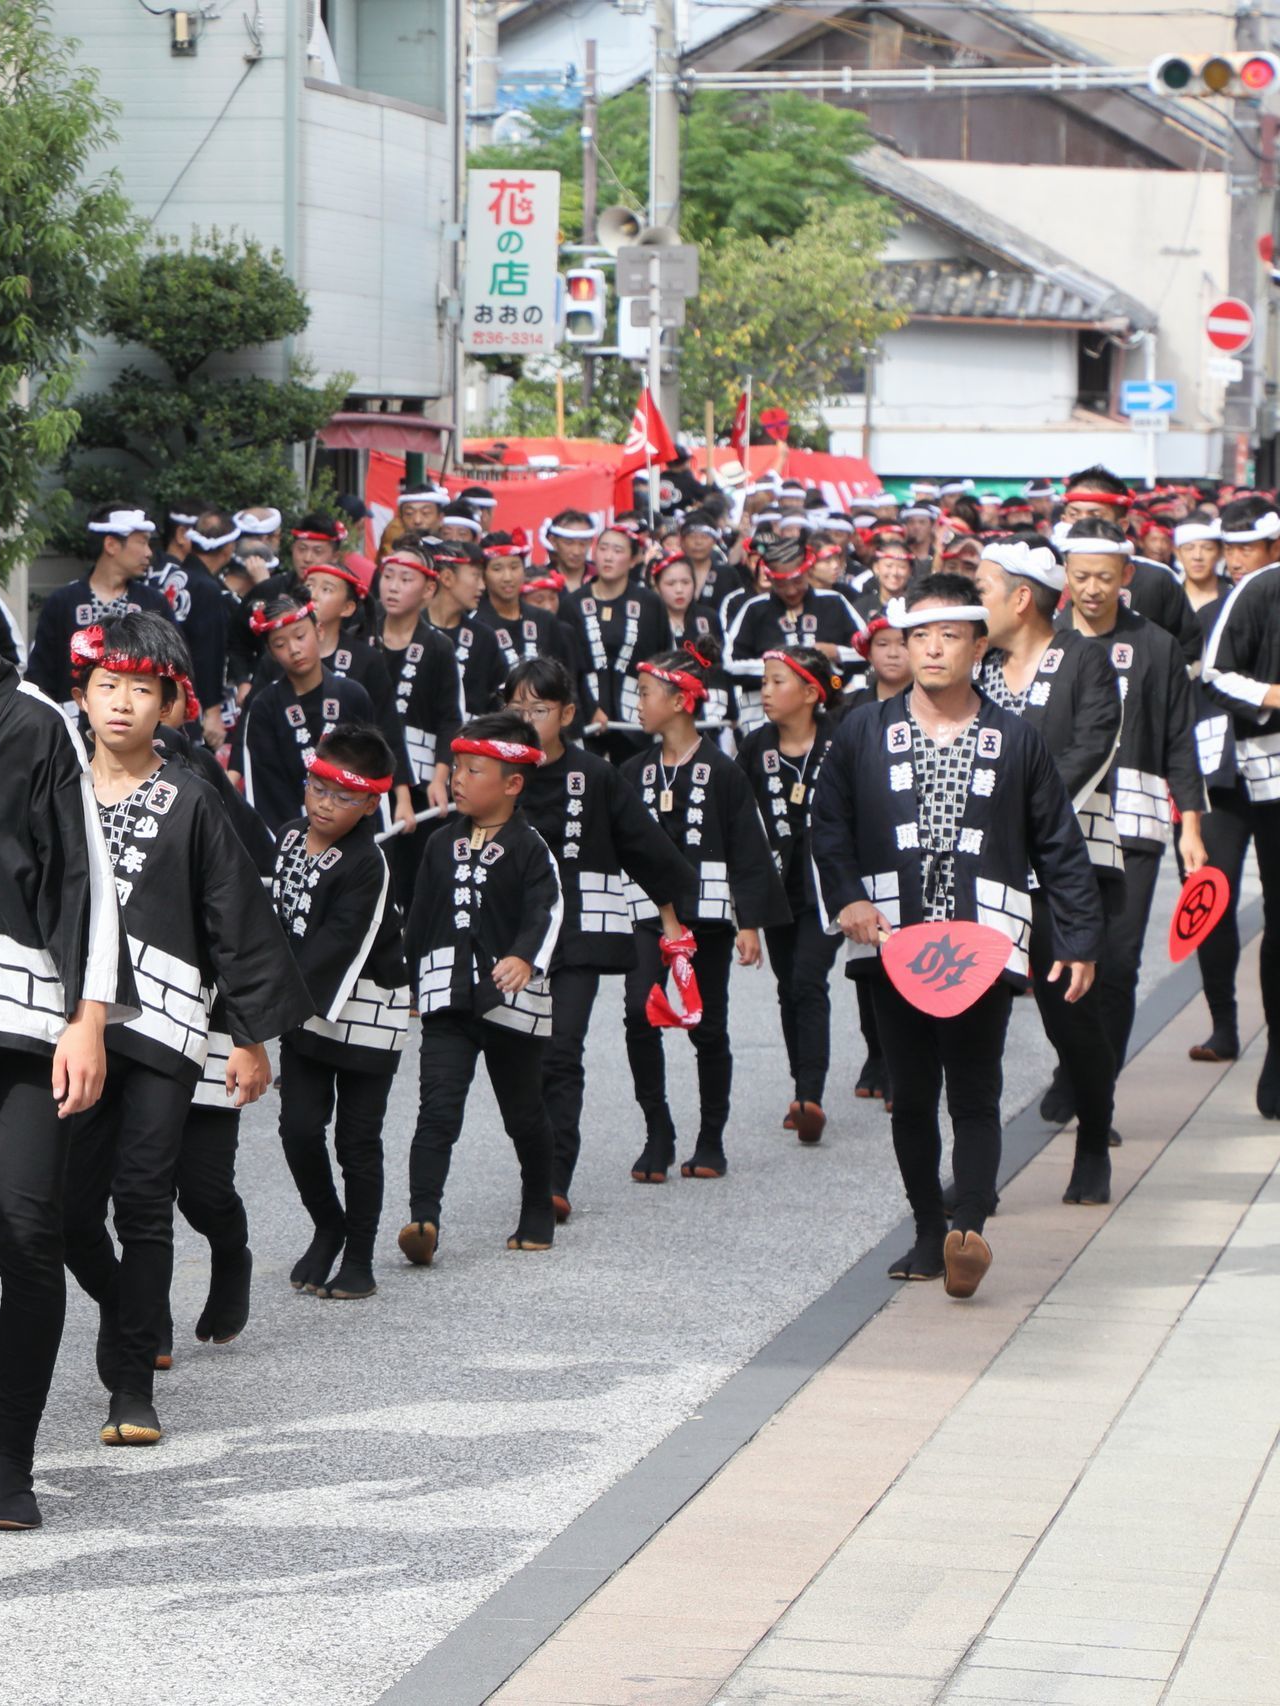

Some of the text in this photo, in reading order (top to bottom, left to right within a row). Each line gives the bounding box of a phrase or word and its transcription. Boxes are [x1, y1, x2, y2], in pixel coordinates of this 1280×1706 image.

[488, 179, 536, 296] 花の店
[474, 304, 543, 325] おおの
